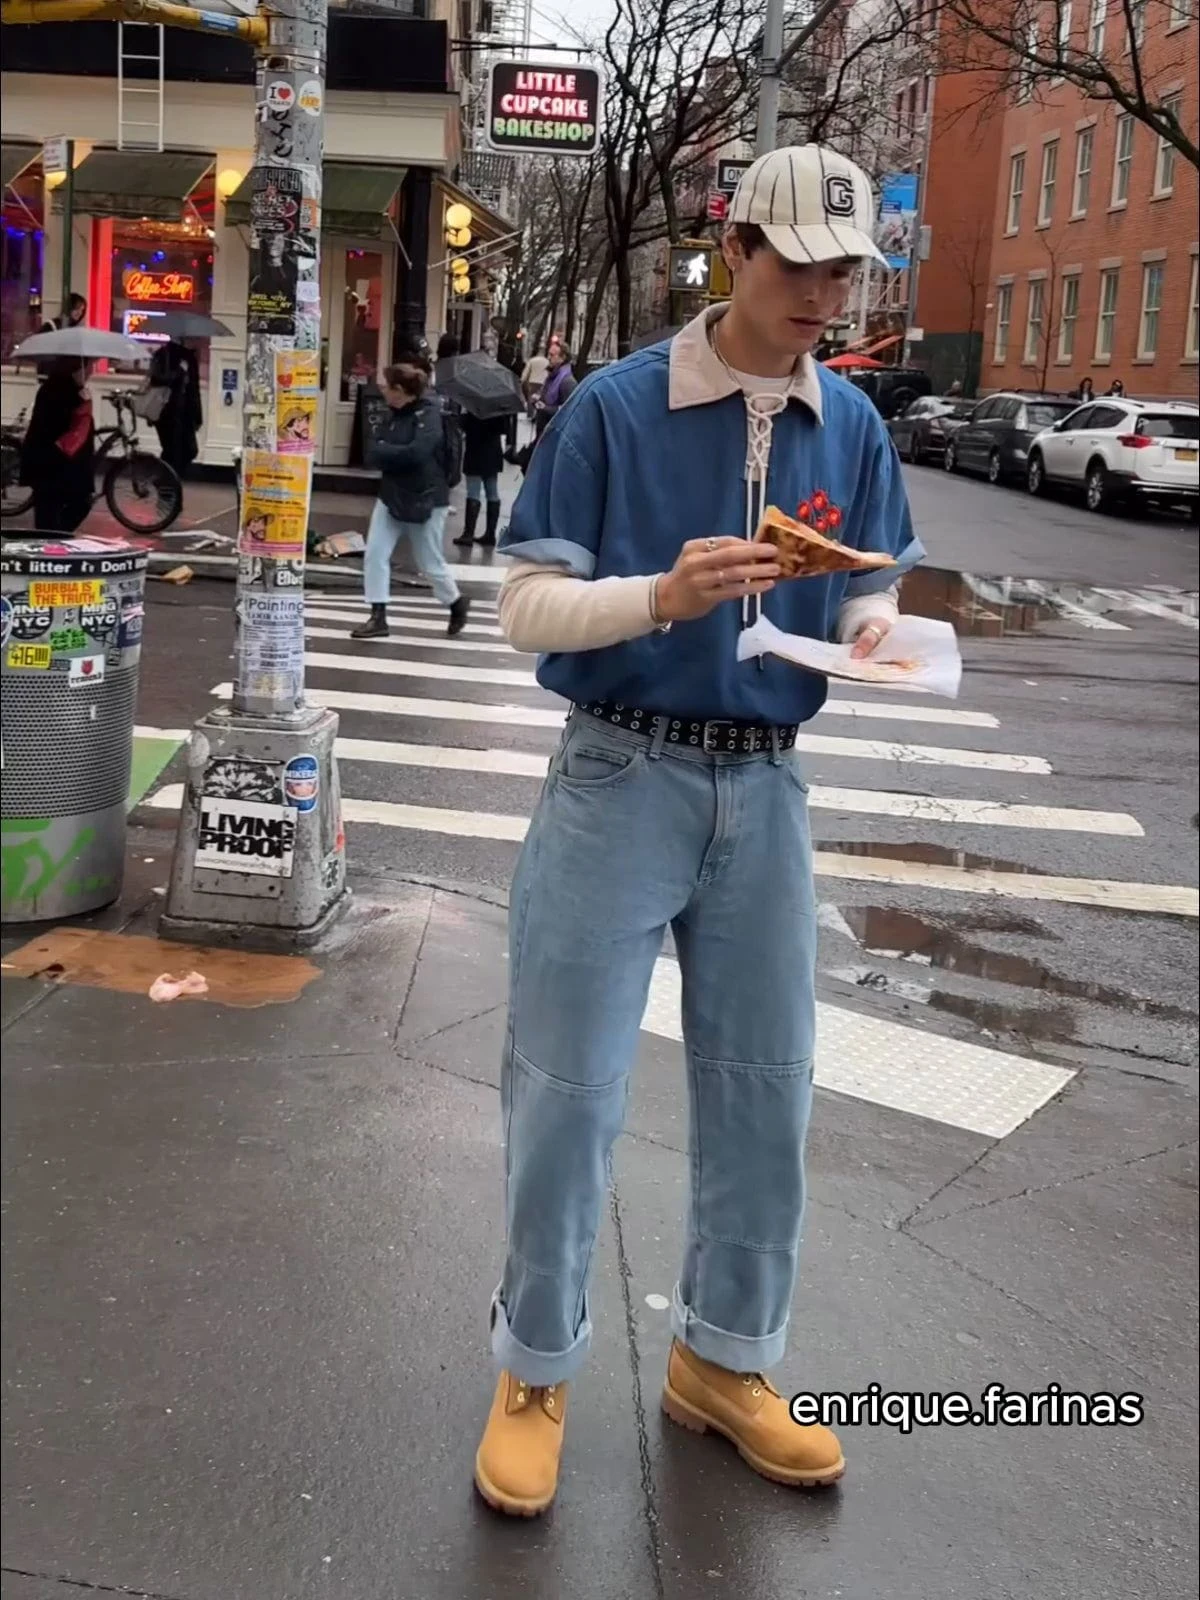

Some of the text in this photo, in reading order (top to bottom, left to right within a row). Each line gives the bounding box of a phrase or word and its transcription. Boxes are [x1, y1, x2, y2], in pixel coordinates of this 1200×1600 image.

[516, 71, 576, 93] LITTLE
[501, 93, 588, 118] CUPCAKE
[493, 117, 594, 141] BAKESHOP
[728, 169, 745, 180] ON
[823, 173, 857, 218] G
[126, 272, 192, 299] Coffee Shop
[1, 561, 22, 572] n't
[29, 561, 72, 573] litter
[101, 560, 133, 573] Don't
[82, 582, 93, 592] IS
[35, 593, 95, 605] THE TRUTH
[249, 598, 305, 614] Painting
[82, 614, 116, 626] NYC
[201, 812, 295, 839] LIVING
[198, 831, 293, 859] PROOF
